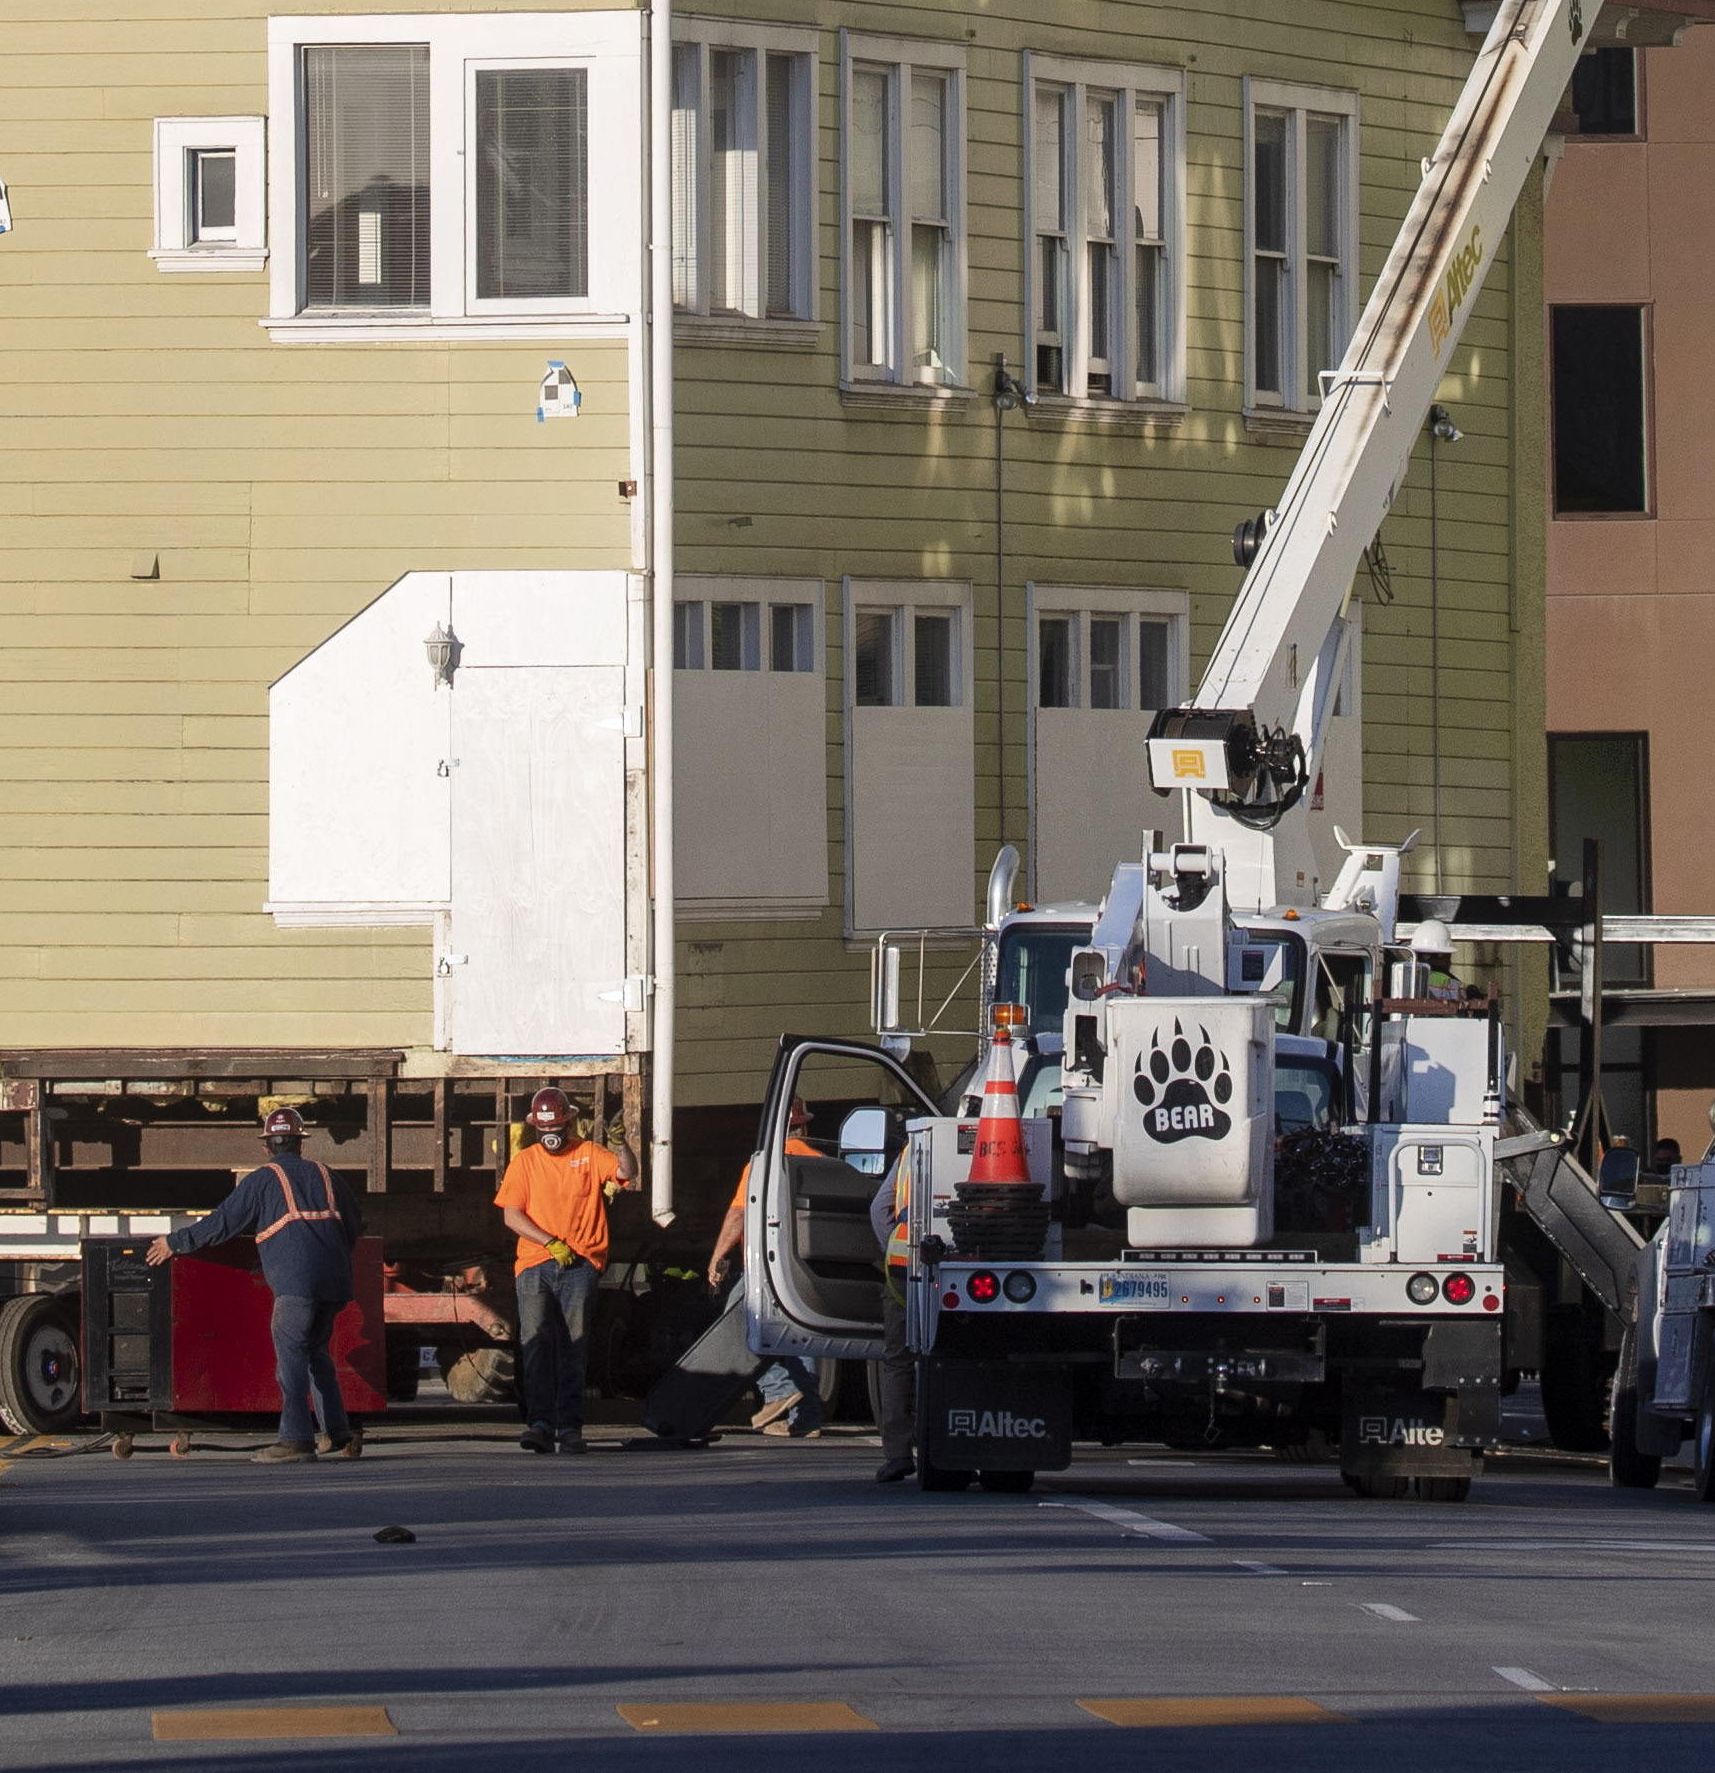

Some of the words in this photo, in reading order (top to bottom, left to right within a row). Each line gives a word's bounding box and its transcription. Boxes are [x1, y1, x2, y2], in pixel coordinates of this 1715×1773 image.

[1446, 224, 1483, 327] Altec
[1155, 1103, 1215, 1132] BEAR
[1114, 1281, 1168, 1298] 2679495
[977, 1411, 1046, 1438] Altec
[1388, 1418, 1445, 1446] Alte
